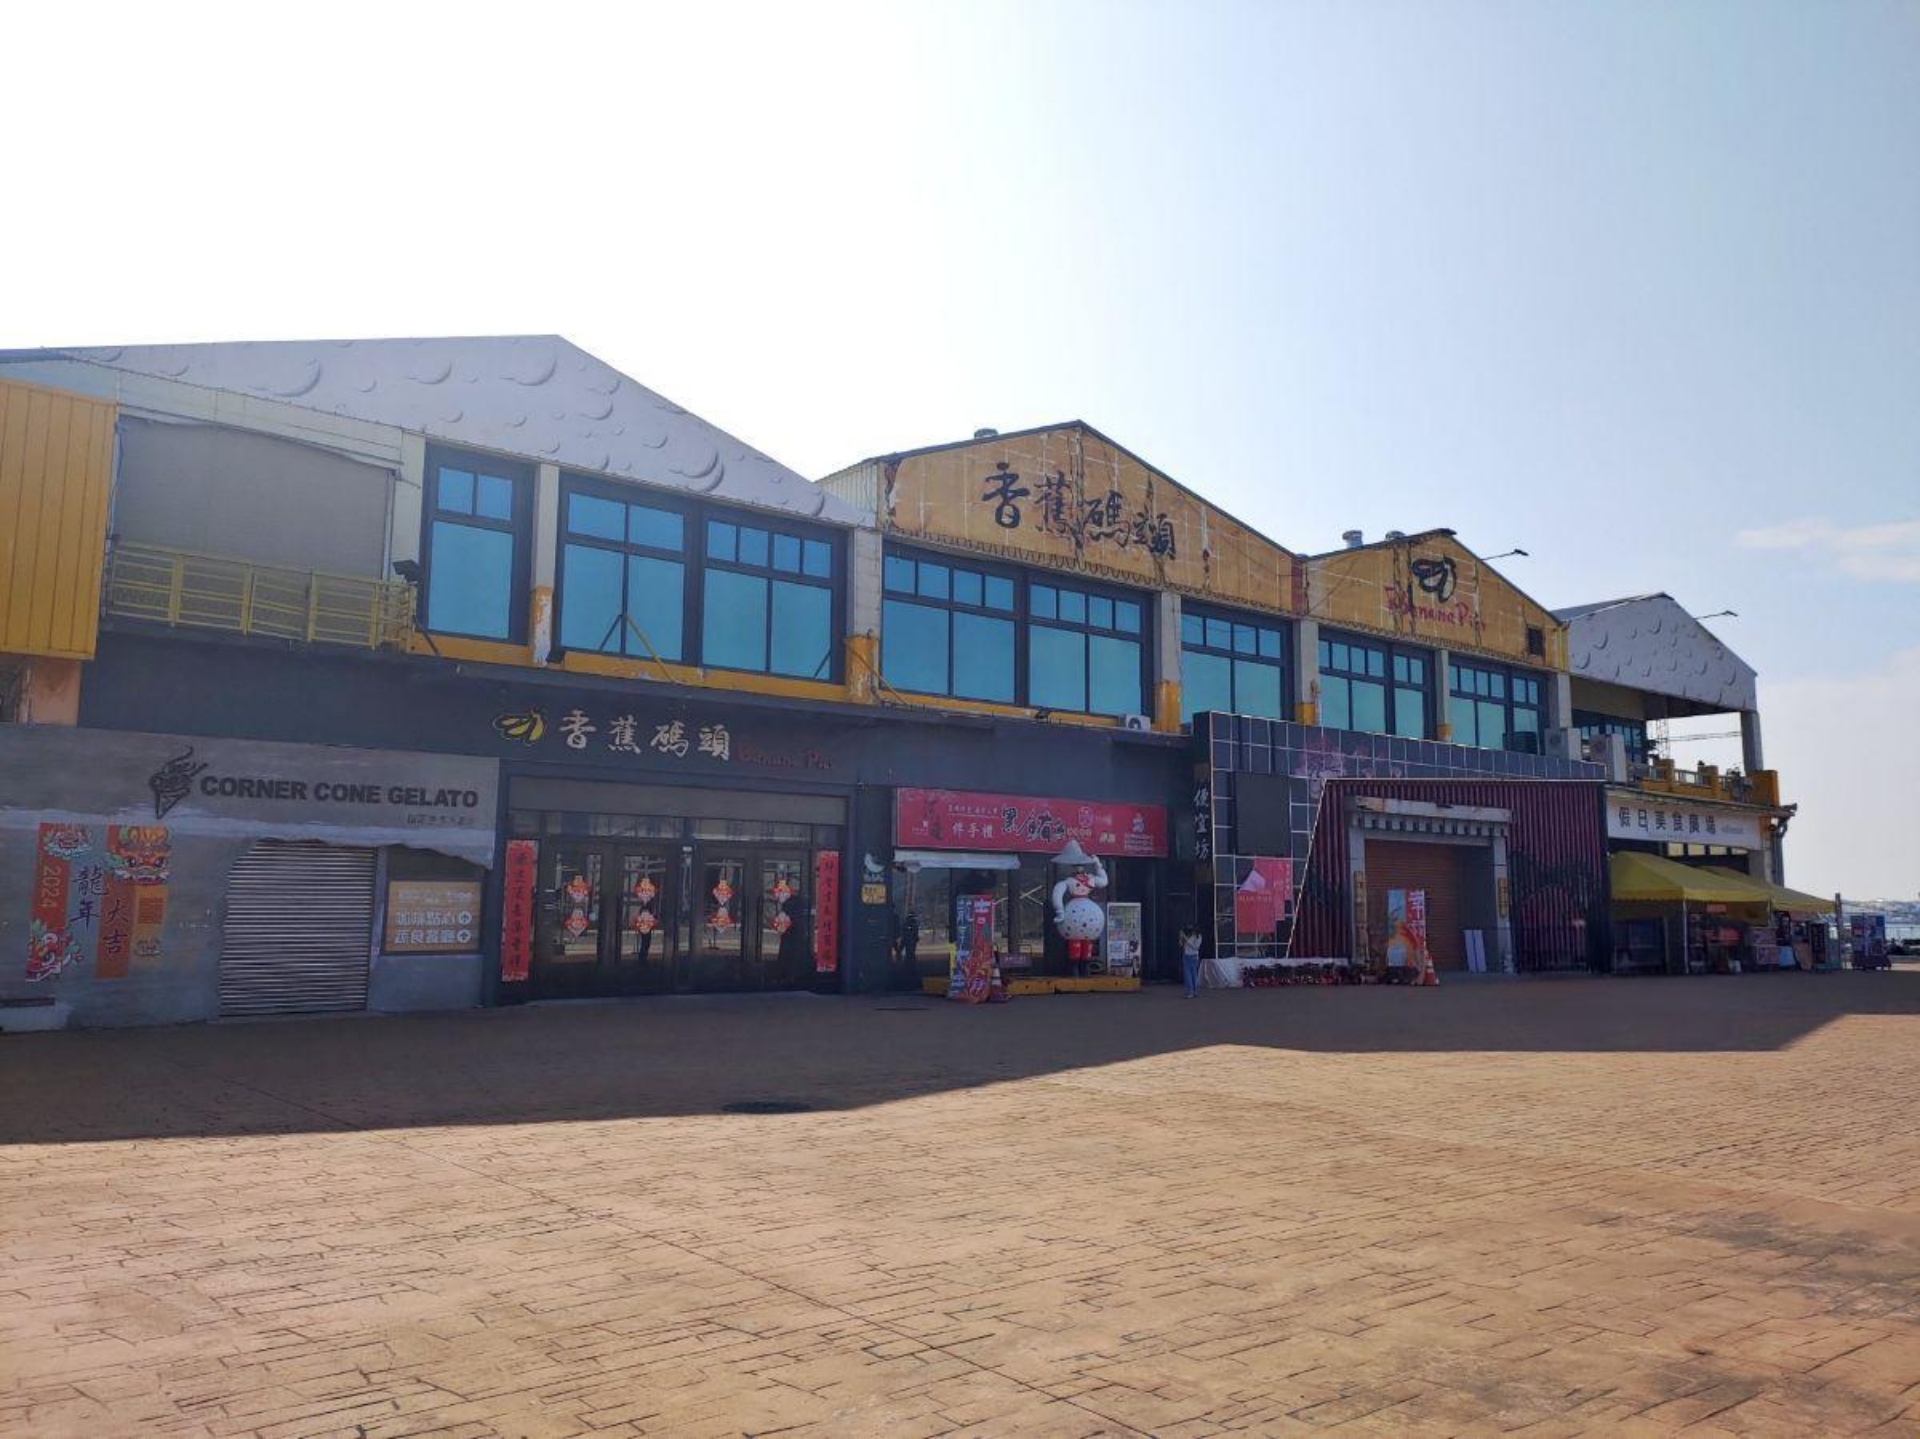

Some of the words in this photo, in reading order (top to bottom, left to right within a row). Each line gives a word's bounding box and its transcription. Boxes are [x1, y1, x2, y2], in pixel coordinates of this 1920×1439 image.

[982, 462, 1177, 561] 香蕉碼頭
[559, 710, 730, 761] 香蕉碼頭
[200, 776, 308, 800] CORNER
[314, 782, 381, 804] CONE
[388, 786, 479, 808] GELATO
[952, 821, 994, 839] 伴手禮
[1193, 787, 1210, 860] 便宜坊
[1618, 806, 1716, 835] 假日美食廣場
[39, 863, 63, 909] 2024
[70, 864, 109, 931] 龍年
[102, 898, 129, 957] 大吉
